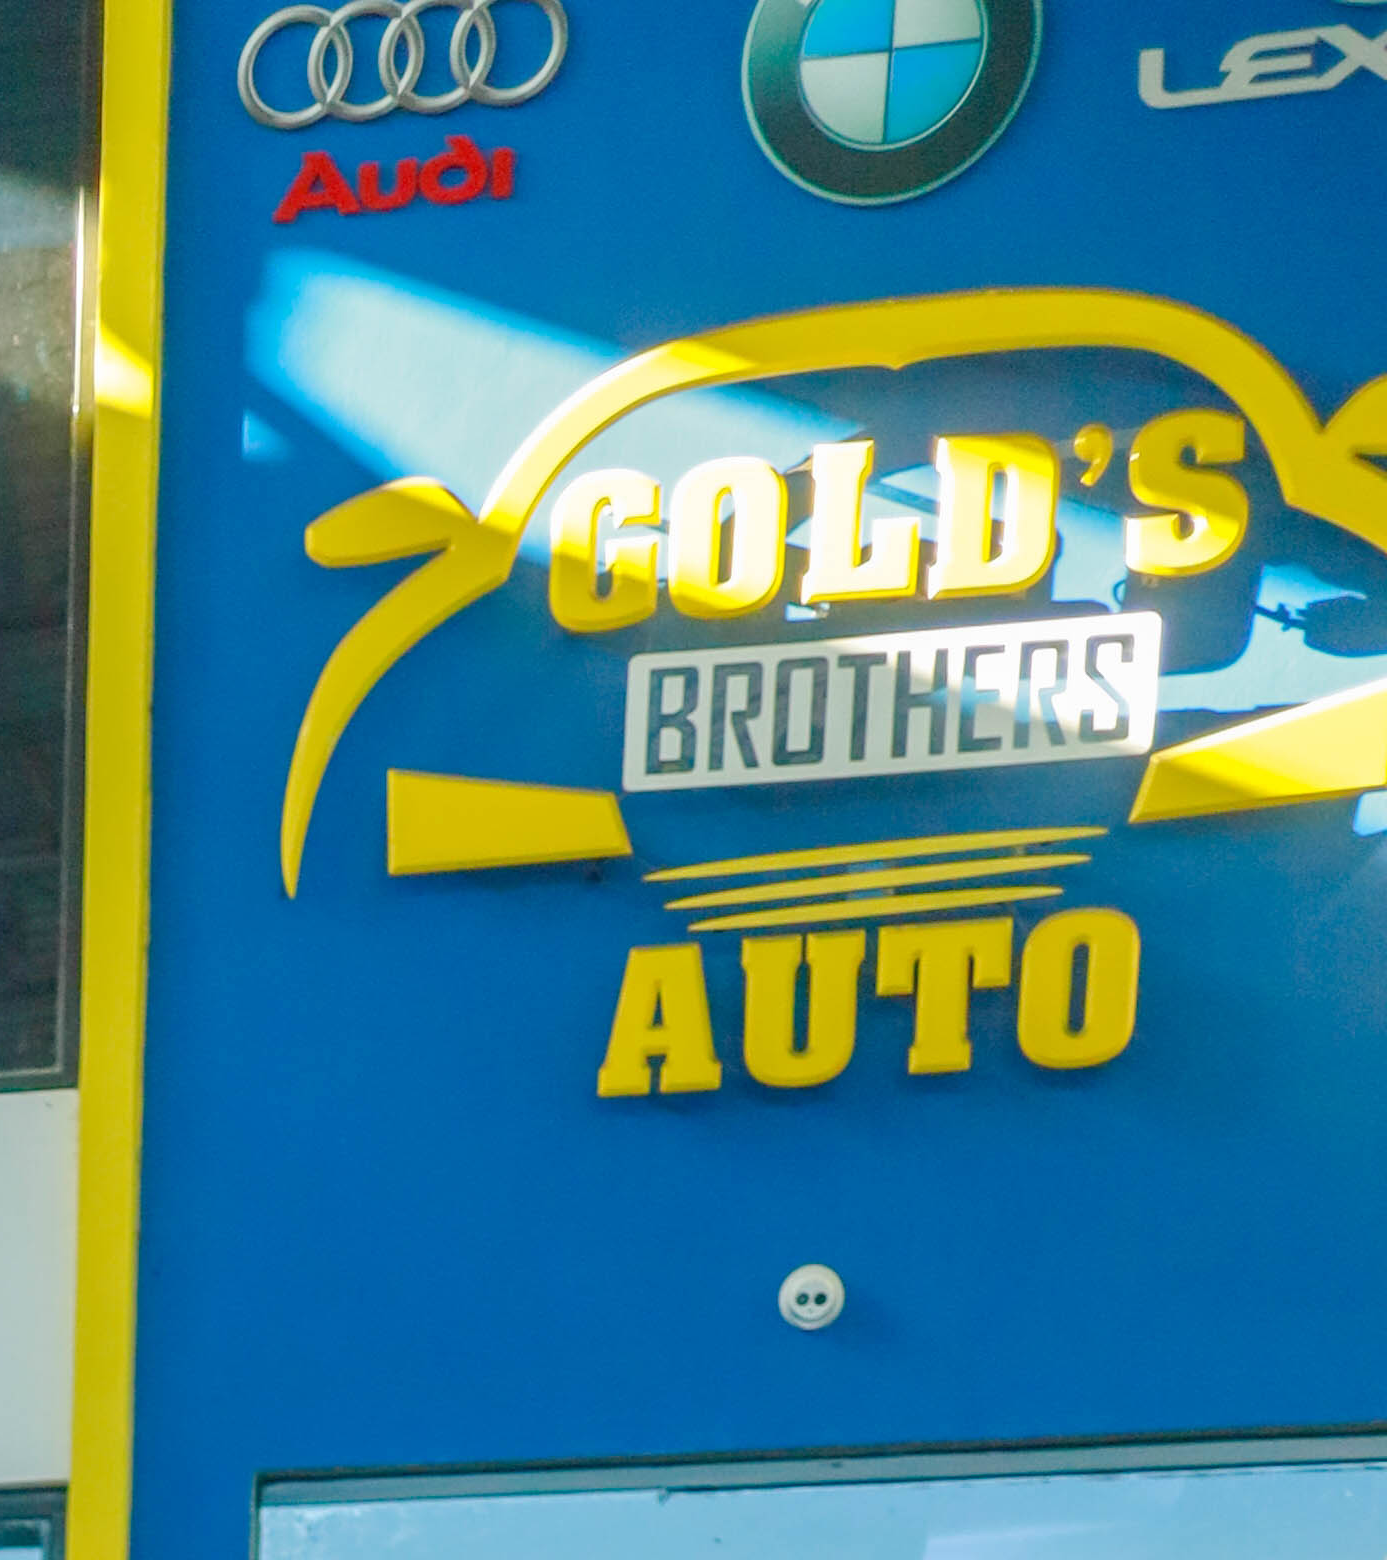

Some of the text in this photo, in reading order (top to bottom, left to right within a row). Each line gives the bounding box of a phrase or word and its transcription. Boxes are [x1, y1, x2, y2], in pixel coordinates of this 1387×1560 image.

[273, 136, 516, 223] Audi
[549, 409, 1250, 633] GOLD'S
[646, 633, 1135, 776] BROTHERS
[597, 907, 1141, 1098] AUTO
